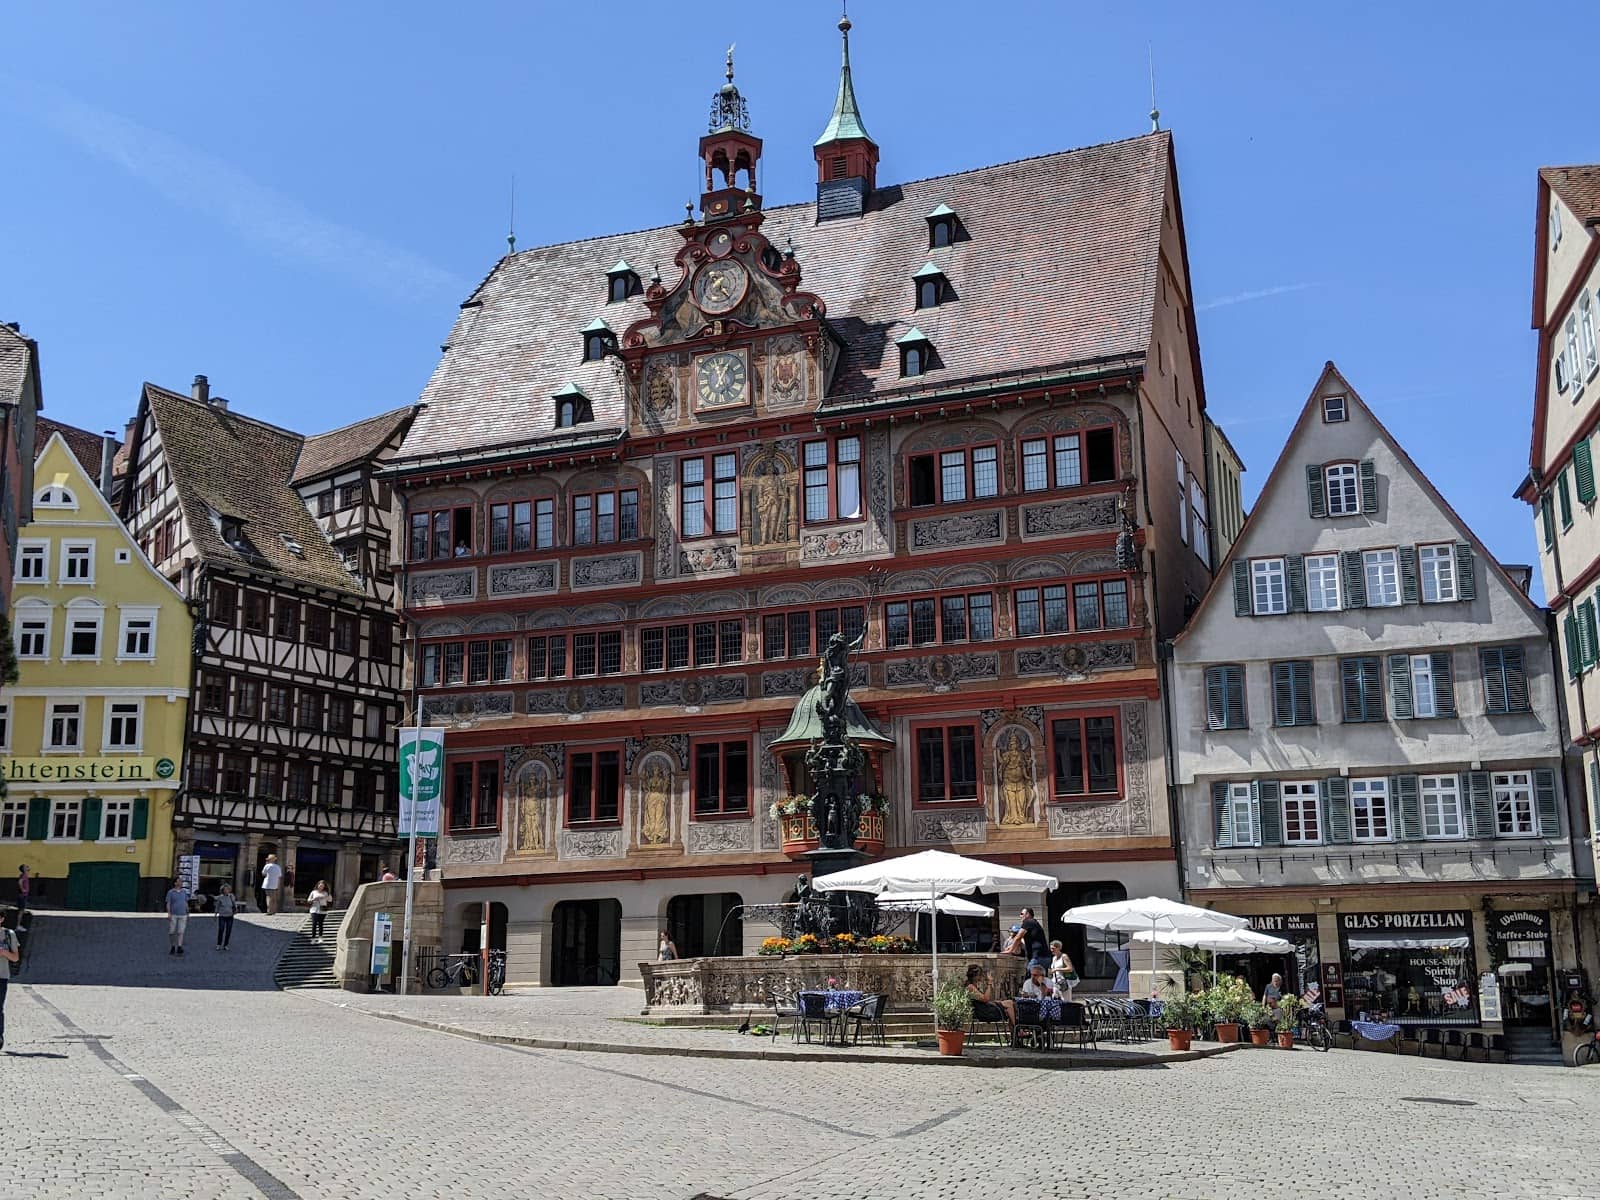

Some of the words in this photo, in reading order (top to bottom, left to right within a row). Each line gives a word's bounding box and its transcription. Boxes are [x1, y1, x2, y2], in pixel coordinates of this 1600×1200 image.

[1247, 916, 1284, 930] UART
[1424, 966, 1456, 978] Spirits
[1433, 976, 1458, 988] Shop
[1443, 986, 1470, 1005] SALE
